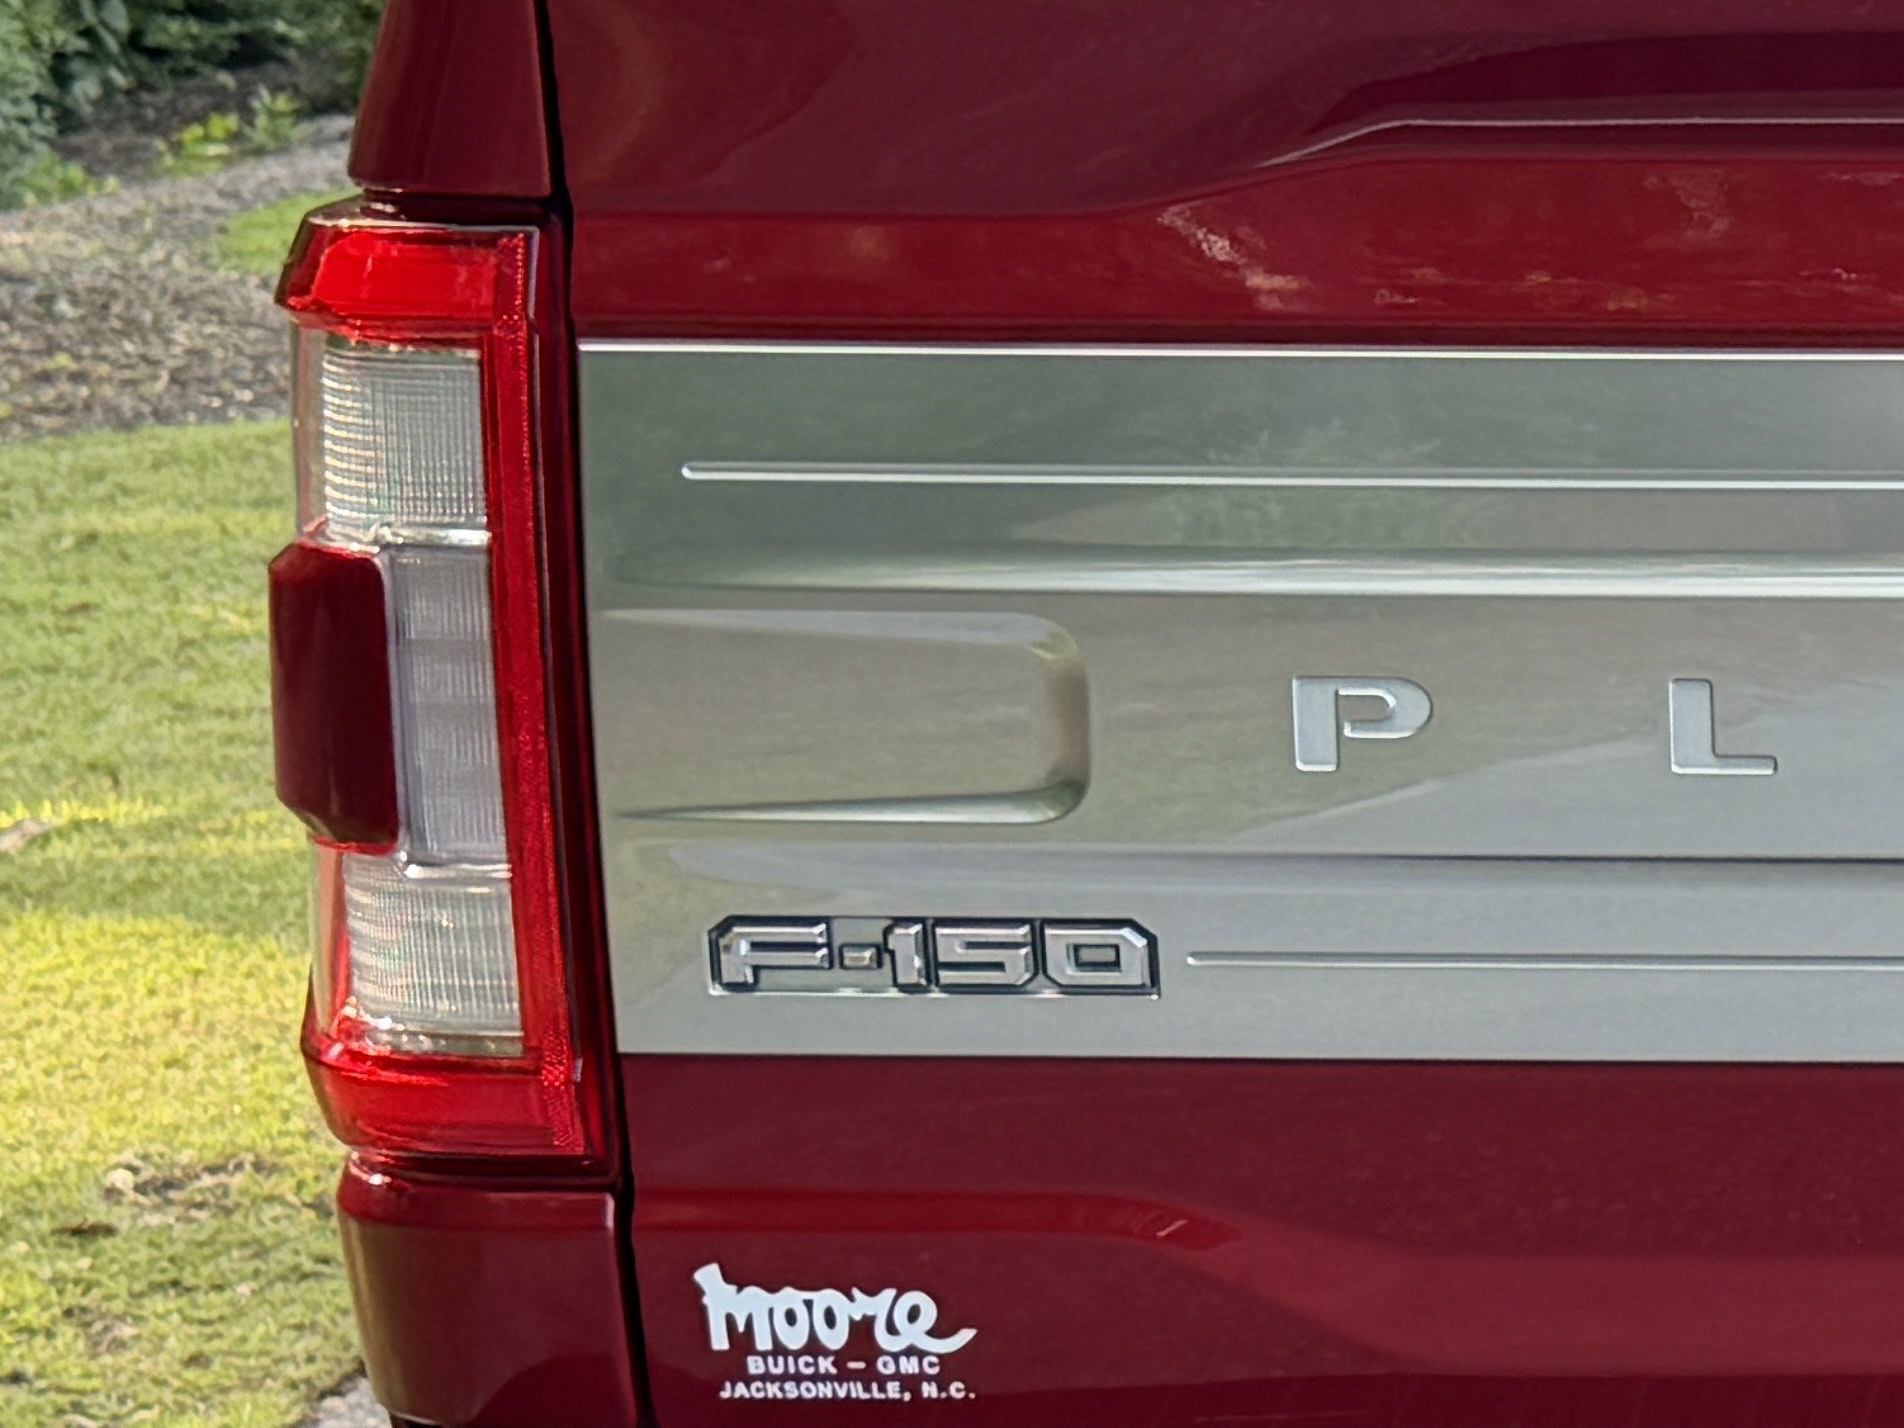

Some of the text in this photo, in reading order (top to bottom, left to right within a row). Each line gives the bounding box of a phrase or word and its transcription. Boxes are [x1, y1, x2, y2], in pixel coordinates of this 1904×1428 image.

[708, 915, 1160, 997] F-150
[746, 1355, 838, 1375] BUICK
[876, 1355, 941, 1374] GMC
[719, 1381, 976, 1402] JACKSONVILLE, N.C.
